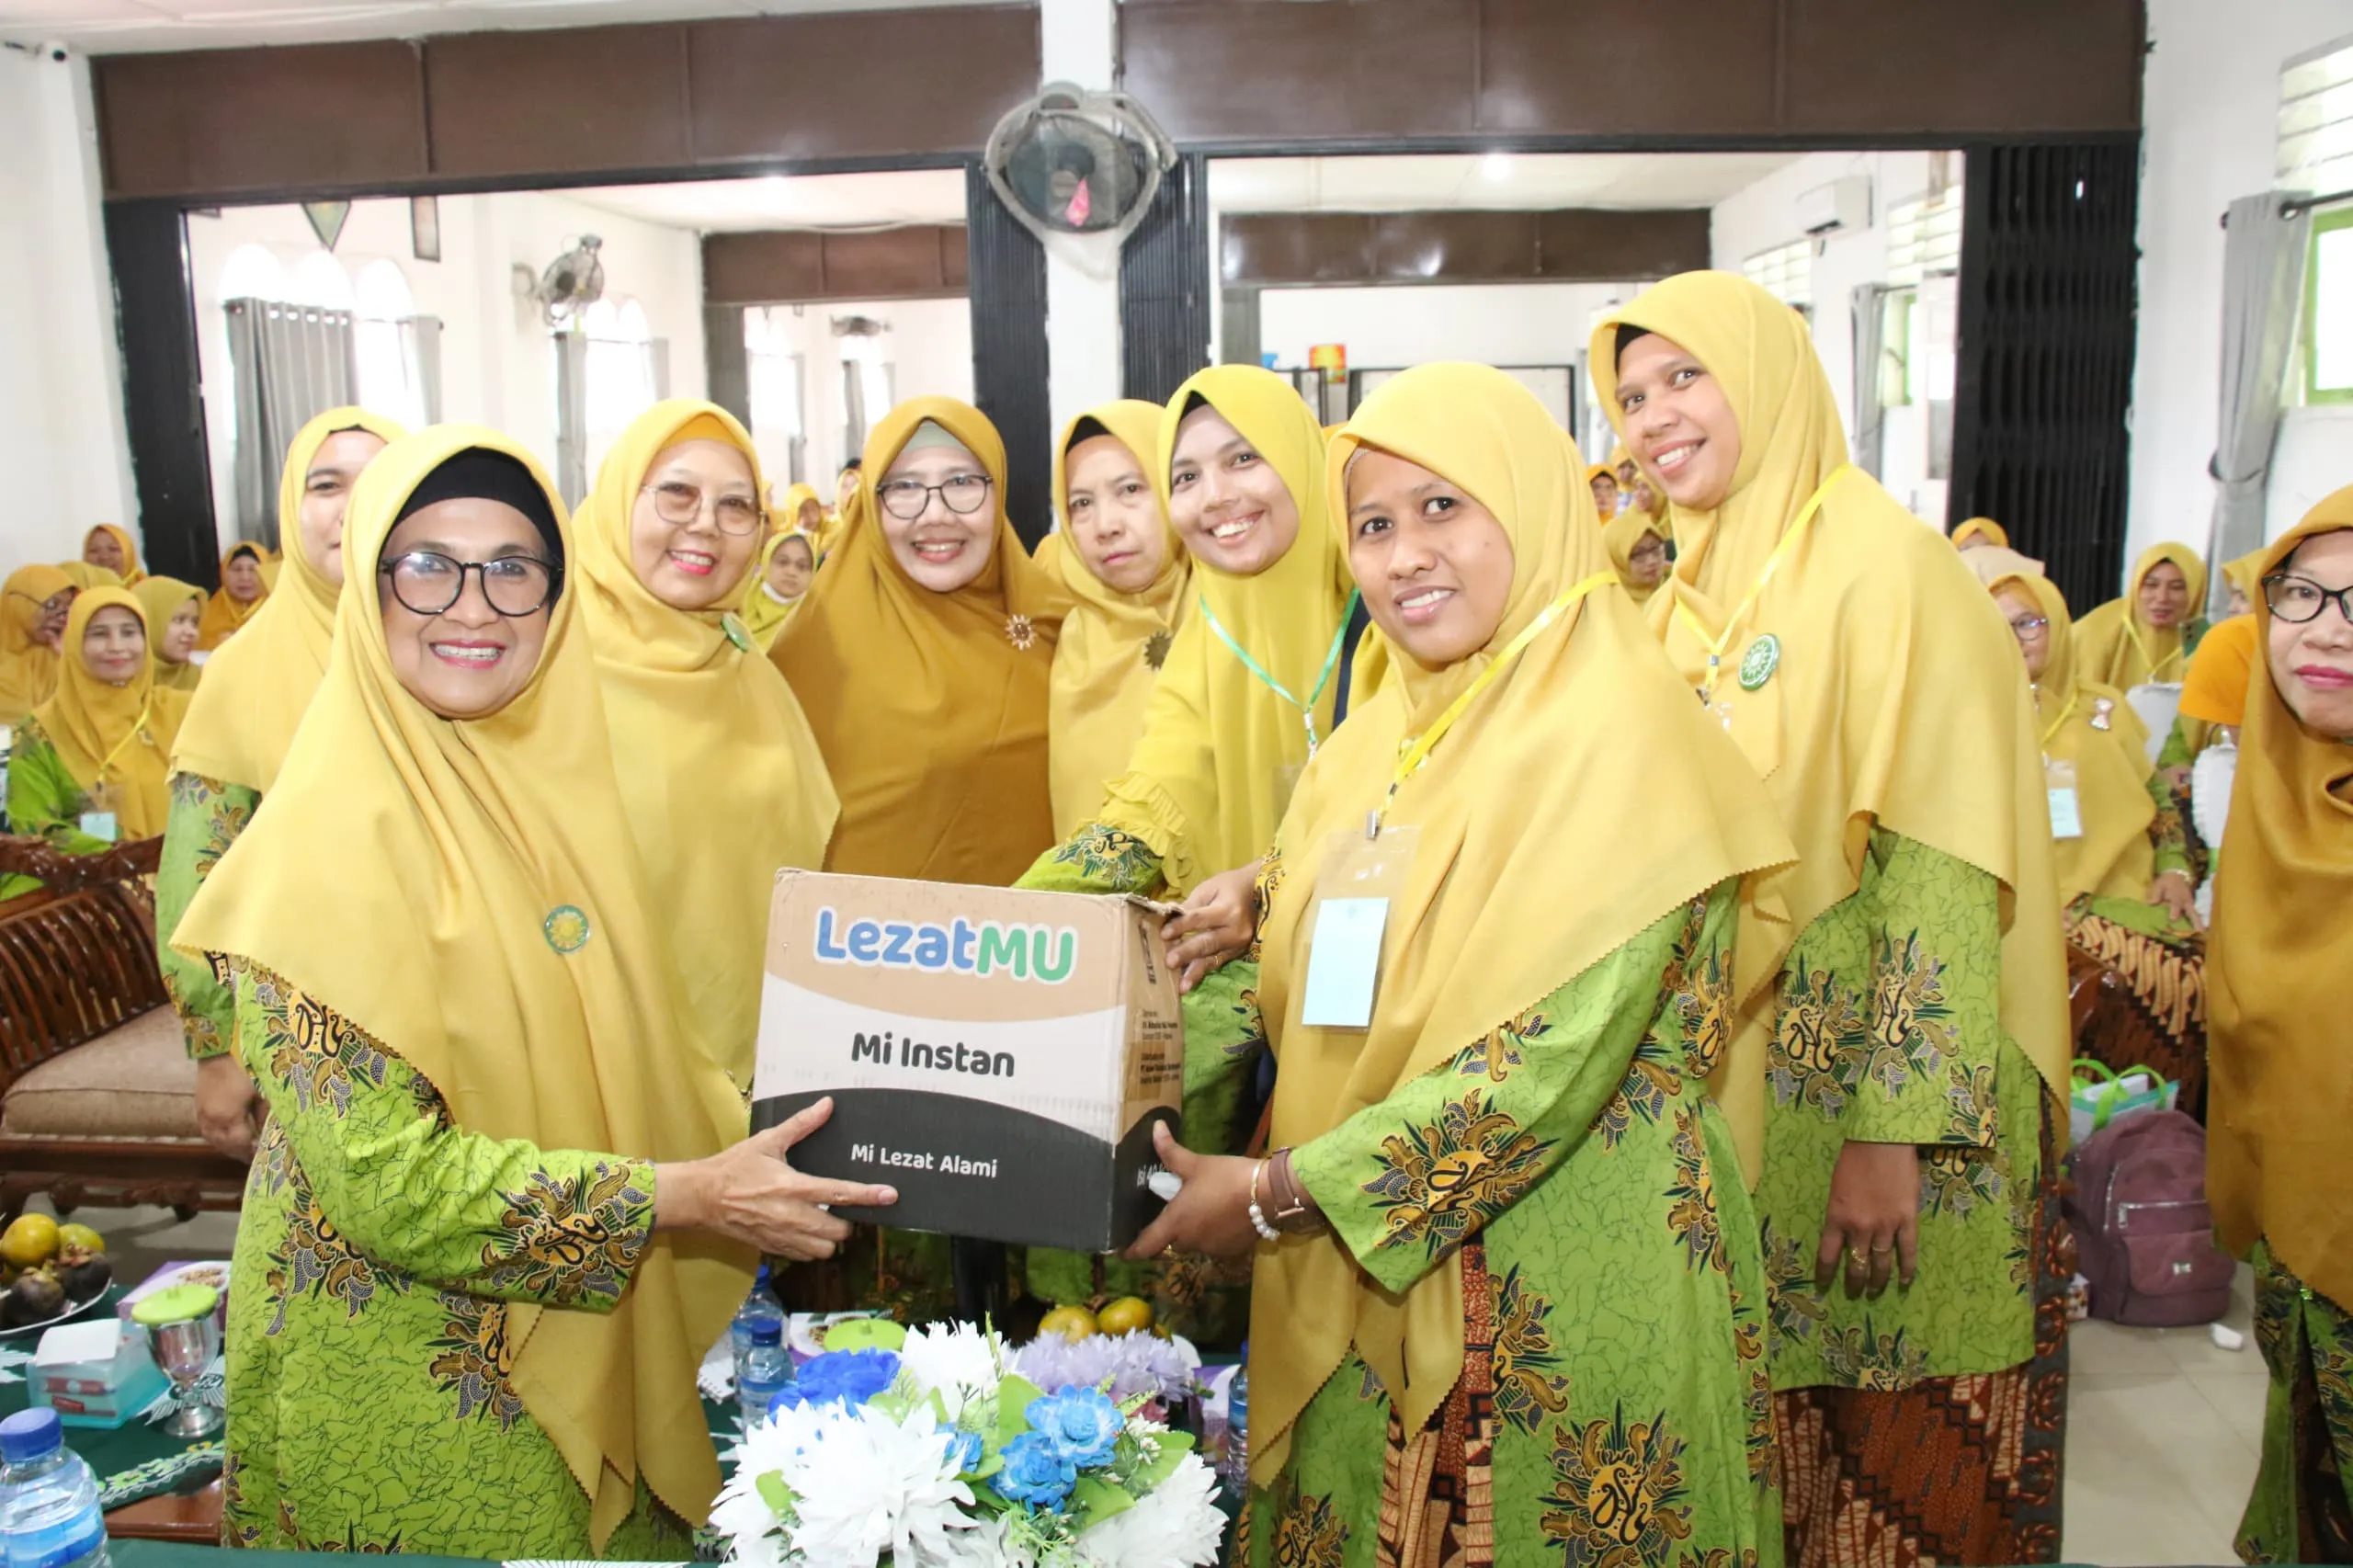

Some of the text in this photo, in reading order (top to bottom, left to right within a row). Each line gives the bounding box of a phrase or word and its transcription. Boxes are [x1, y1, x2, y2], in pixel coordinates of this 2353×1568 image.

[815, 908, 1074, 982] LezatMU
[851, 1031, 1015, 1078] Mi Instan
[851, 1143, 997, 1178] Mi Lezat Alami
